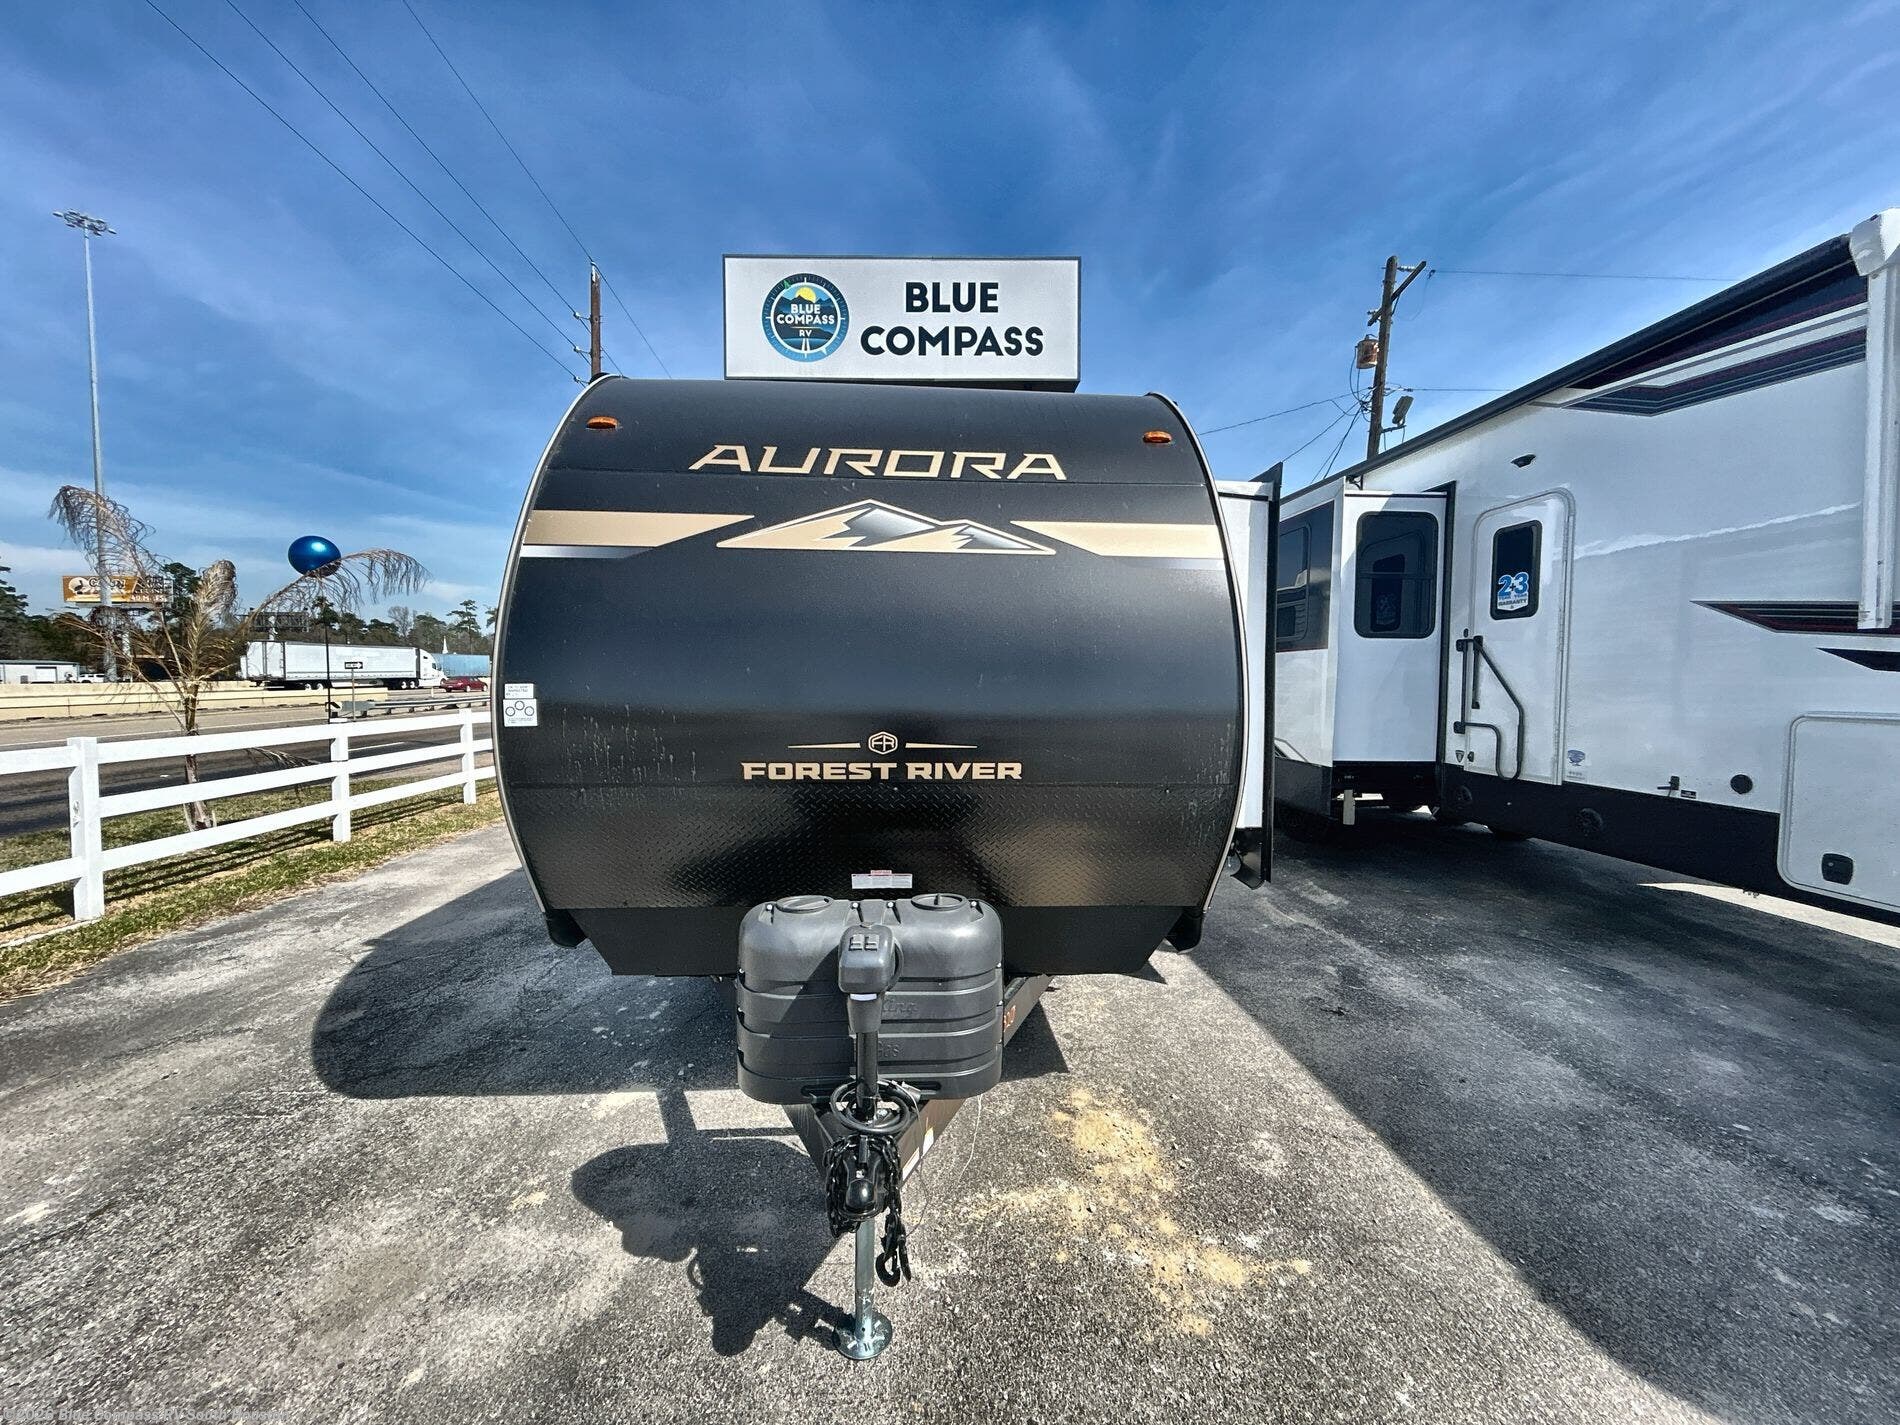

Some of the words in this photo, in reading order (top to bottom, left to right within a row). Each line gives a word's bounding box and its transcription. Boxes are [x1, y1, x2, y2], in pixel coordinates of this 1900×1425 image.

[905, 281, 999, 313] BLUE
[790, 303, 821, 314] BLUE
[776, 314, 835, 325] COMPASS
[799, 329, 812, 337] RV
[860, 325, 1044, 357] COMPASS
[688, 444, 1067, 480] AURORA
[741, 762, 898, 780] FOREST
[905, 762, 1023, 780] RIVER
